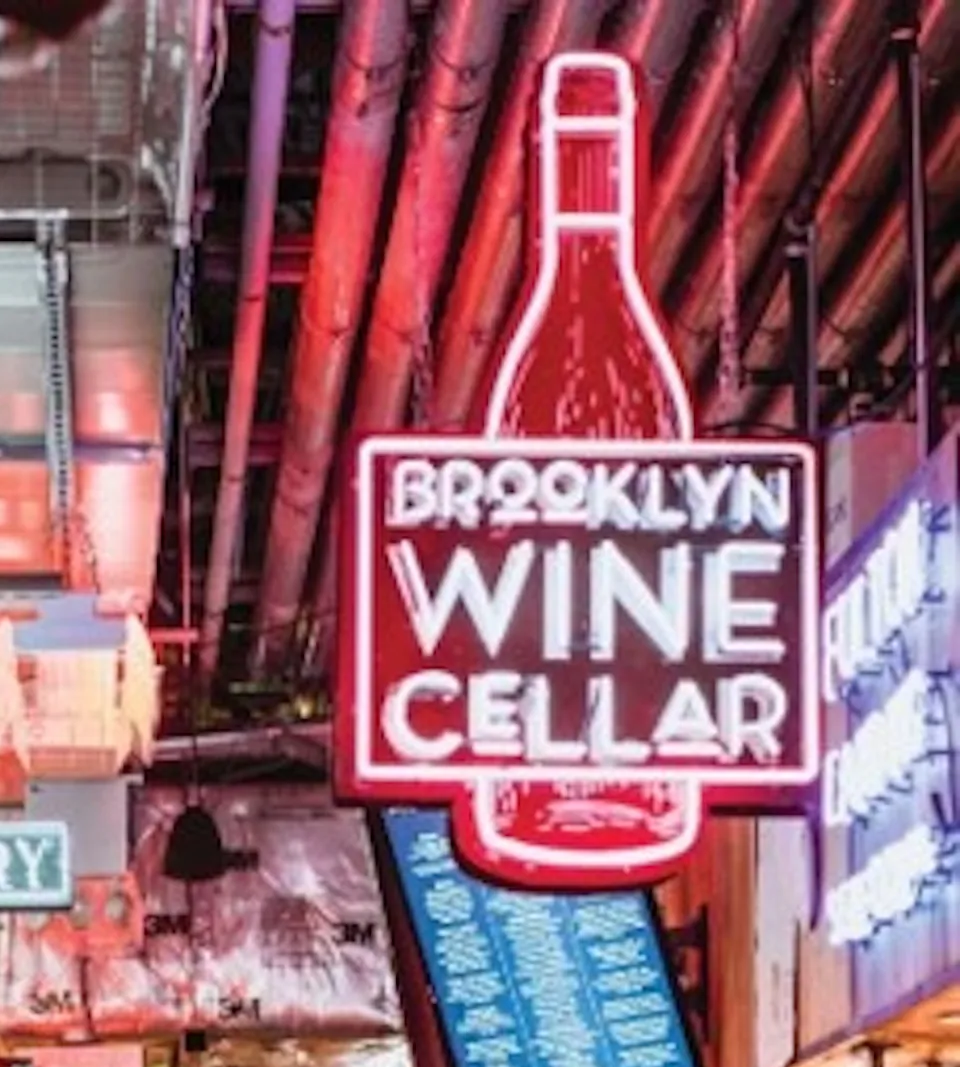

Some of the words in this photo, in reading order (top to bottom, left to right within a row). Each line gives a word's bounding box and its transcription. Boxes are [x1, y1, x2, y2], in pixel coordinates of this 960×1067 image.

[386, 459, 790, 531] BROOKLYN
[386, 539, 786, 662] WINE
[382, 670, 787, 763] CELLAR
[144, 914, 190, 936] 3M
